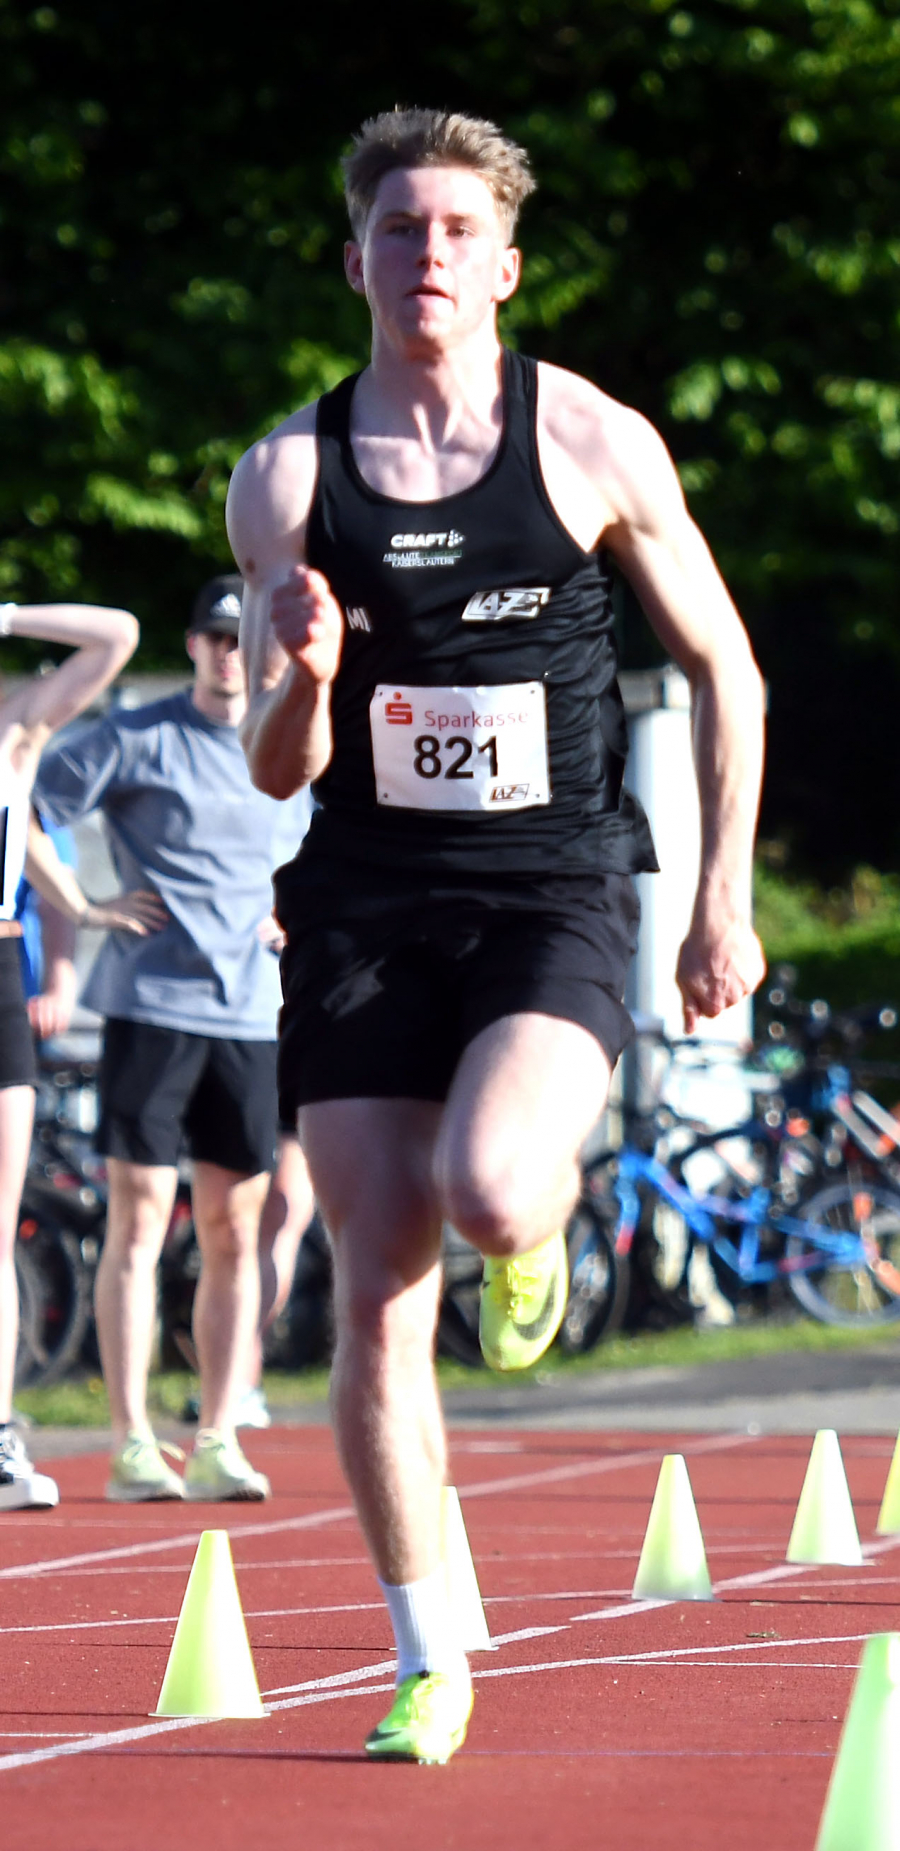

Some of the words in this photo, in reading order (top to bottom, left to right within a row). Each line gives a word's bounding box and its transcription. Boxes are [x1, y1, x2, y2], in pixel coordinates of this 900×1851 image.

[390, 533, 447, 547] CRAFT
[424, 710, 529, 731] Sparkasse
[413, 734, 499, 780] 821
